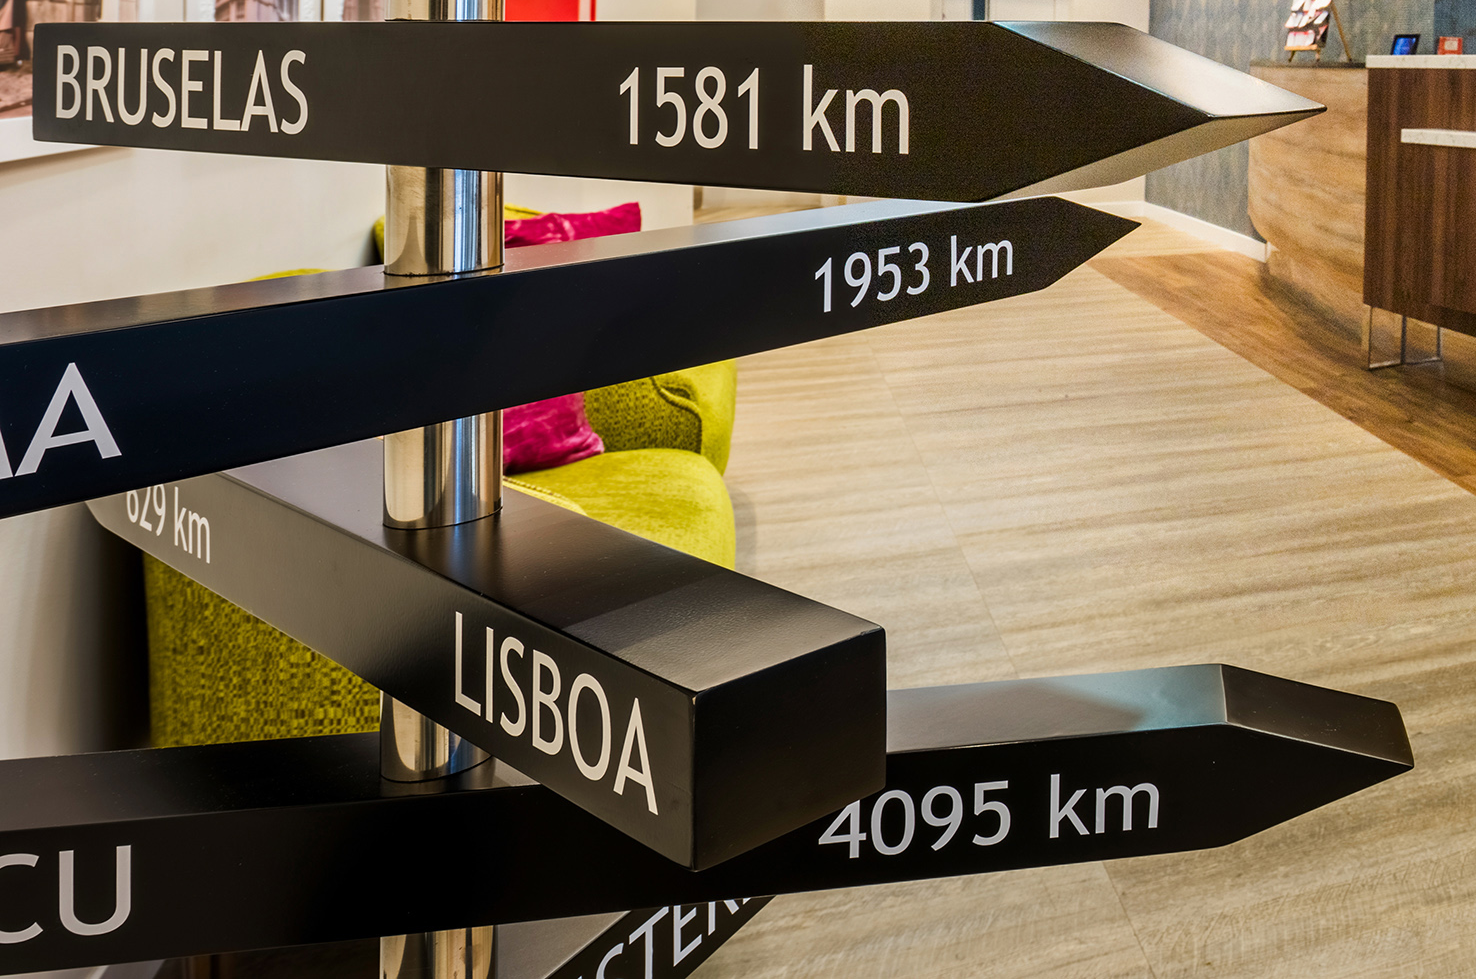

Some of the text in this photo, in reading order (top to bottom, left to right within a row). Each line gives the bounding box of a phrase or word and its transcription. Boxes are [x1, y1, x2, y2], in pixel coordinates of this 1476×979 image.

[55, 44, 910, 155] BRUSELAS 1581 km
[0, 234, 1014, 480] A 1953 km
[174, 486, 210, 564] km
[454, 610, 660, 816] LISBOA
[818, 780, 1011, 858] 4095
[1048, 773, 1160, 838] km
